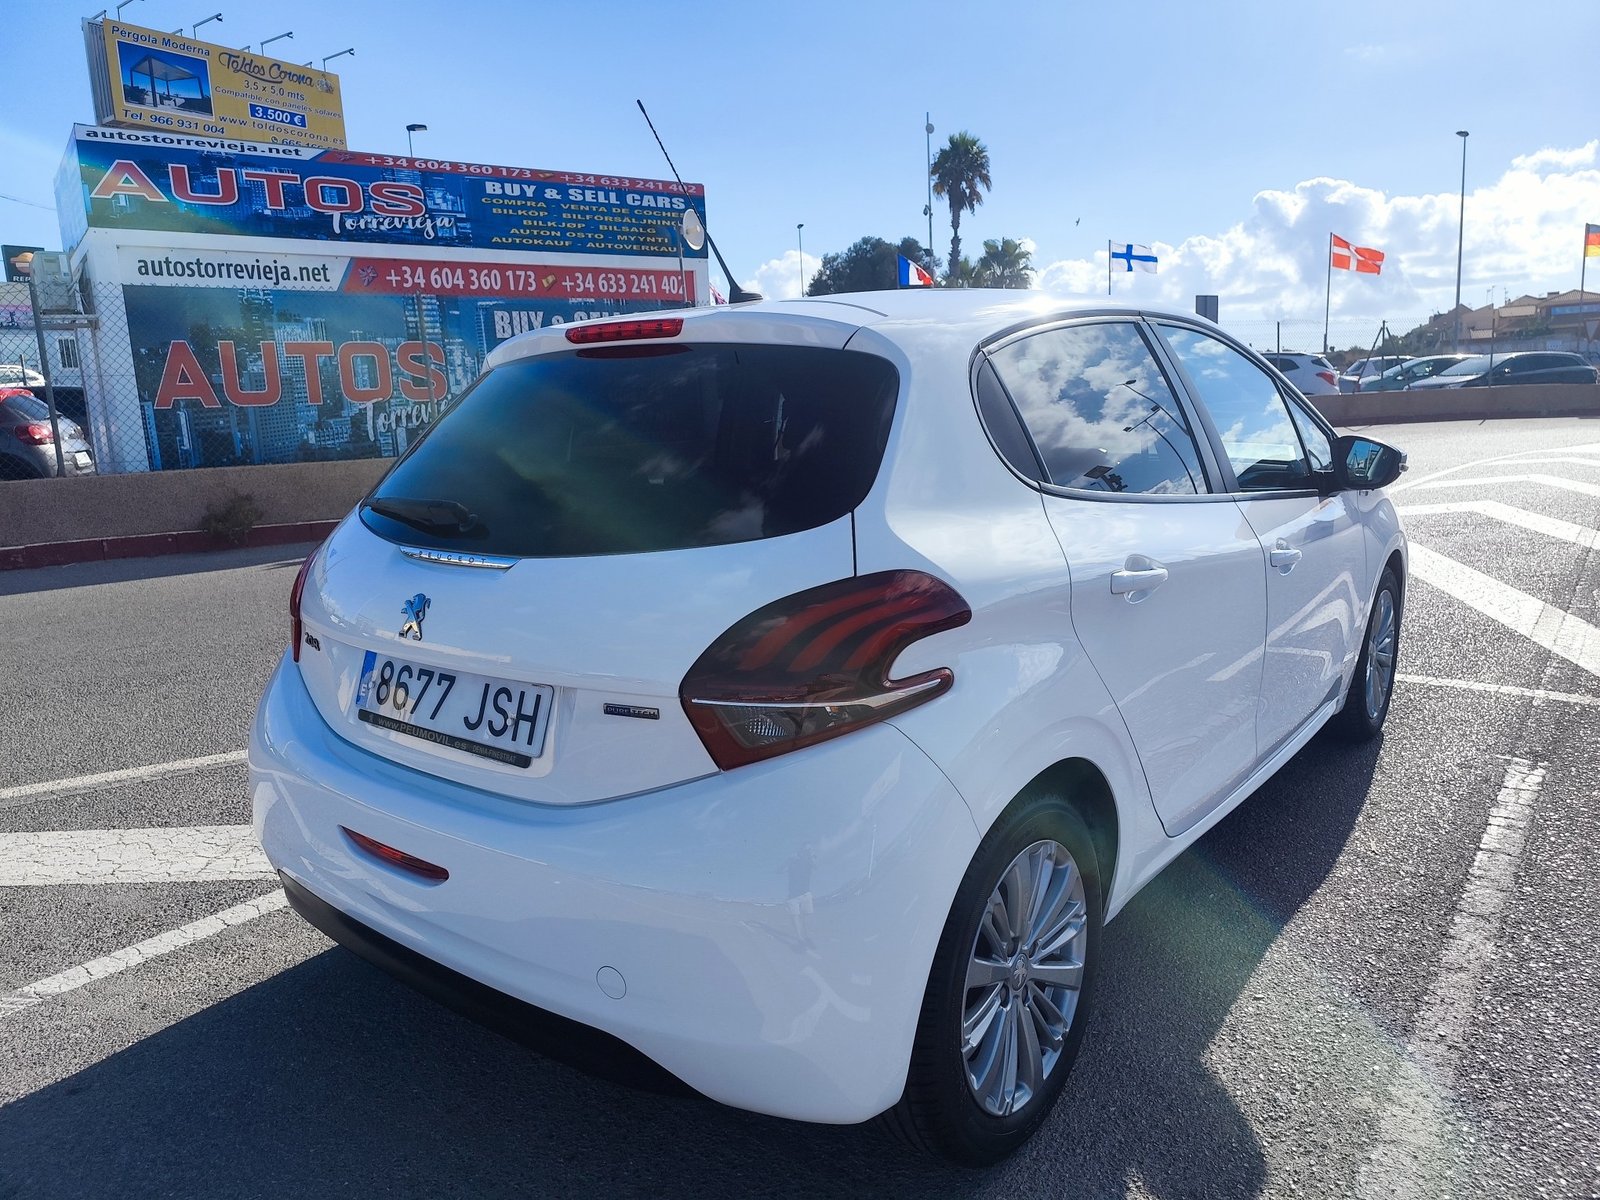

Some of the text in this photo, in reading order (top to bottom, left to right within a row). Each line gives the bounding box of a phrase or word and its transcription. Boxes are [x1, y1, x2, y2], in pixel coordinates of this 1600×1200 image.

[112, 26, 210, 56] Pérgola Moderna
[218, 52, 314, 87] Toldos Corona
[215, 86, 342, 119] Compatible con paneles solares
[255, 106, 302, 126] 3.500 €
[122, 109, 225, 135] Tel. 966 931 004
[218, 115, 344, 145] www.toldoscorona.es
[86, 128, 302, 157] autostorrevieja.net
[365, 156, 532, 178] +34 604 360 173
[90, 160, 425, 217] AUTOS
[485, 181, 686, 210] BUY & SELL CARS
[560, 174, 696, 194] +34 633 241 402
[482, 198, 547, 208] COMPRA
[560, 204, 608, 212] VENTA
[325, 209, 454, 239] Torrevieja
[510, 228, 561, 236] AUTON
[566, 231, 604, 239] OSTO
[617, 235, 668, 243] MYYNTI
[600, 224, 656, 234] BILSALG
[492, 236, 572, 246] AUTOKAUF
[586, 242, 680, 252] AUTOVERKAU
[137, 256, 331, 286] autostorrevieja.net
[386, 266, 536, 292] +34 604 360 173
[562, 272, 684, 295] +34 633 241 402
[494, 310, 544, 338] BUY
[154, 340, 448, 408] AUTOS
[358, 396, 450, 441] Torrevie
[418, 550, 487, 564] PEUGEOT
[376, 660, 542, 746] 8677 JSH
[378, 716, 468, 750] www.PEUMOVIL.es
